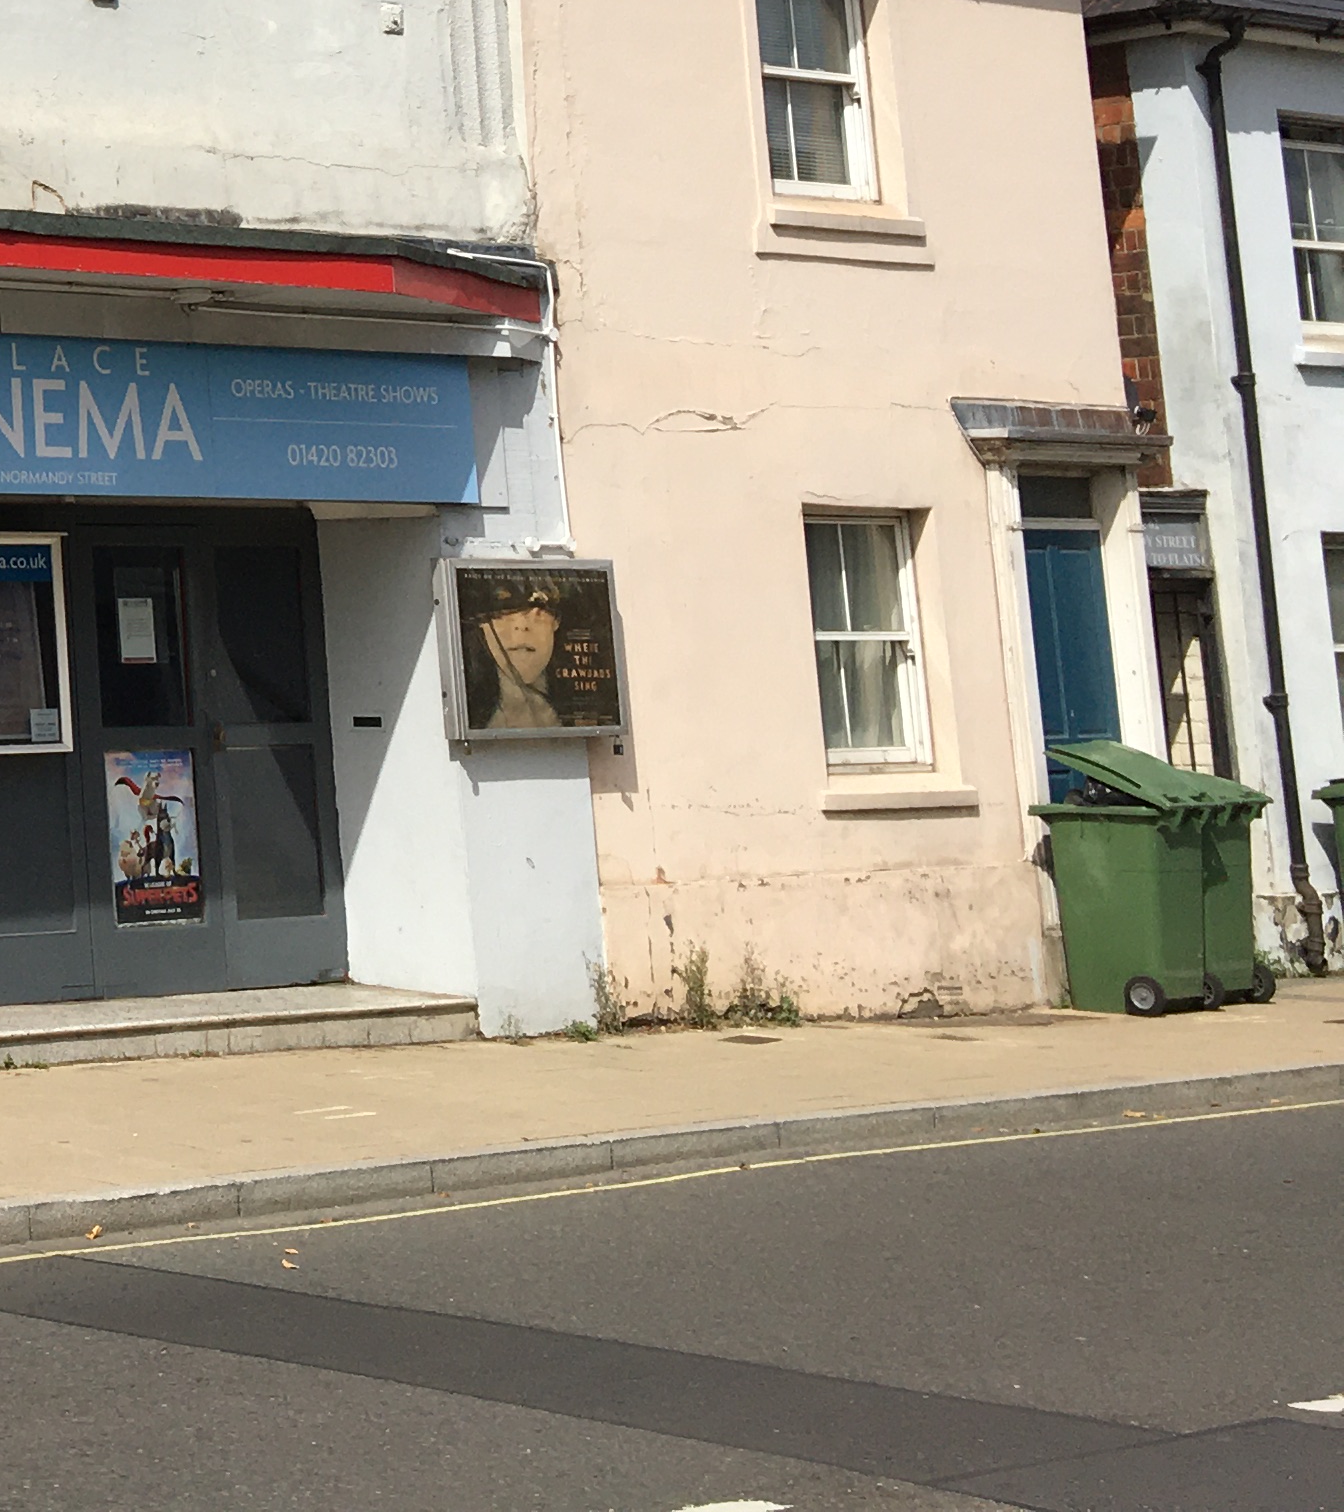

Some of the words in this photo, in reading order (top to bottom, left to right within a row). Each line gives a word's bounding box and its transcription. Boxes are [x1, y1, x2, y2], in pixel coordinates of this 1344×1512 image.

[231, 378, 295, 400] OPERAS
[309, 381, 378, 404] THEATRE
[380, 384, 439, 406] SHOWS
[287, 444, 341, 467] 01420
[346, 446, 398, 469] 82303
[0, 470, 74, 486] NORMANDY
[77, 471, 118, 487] STREET
[1155, 535, 1197, 548] STREET
